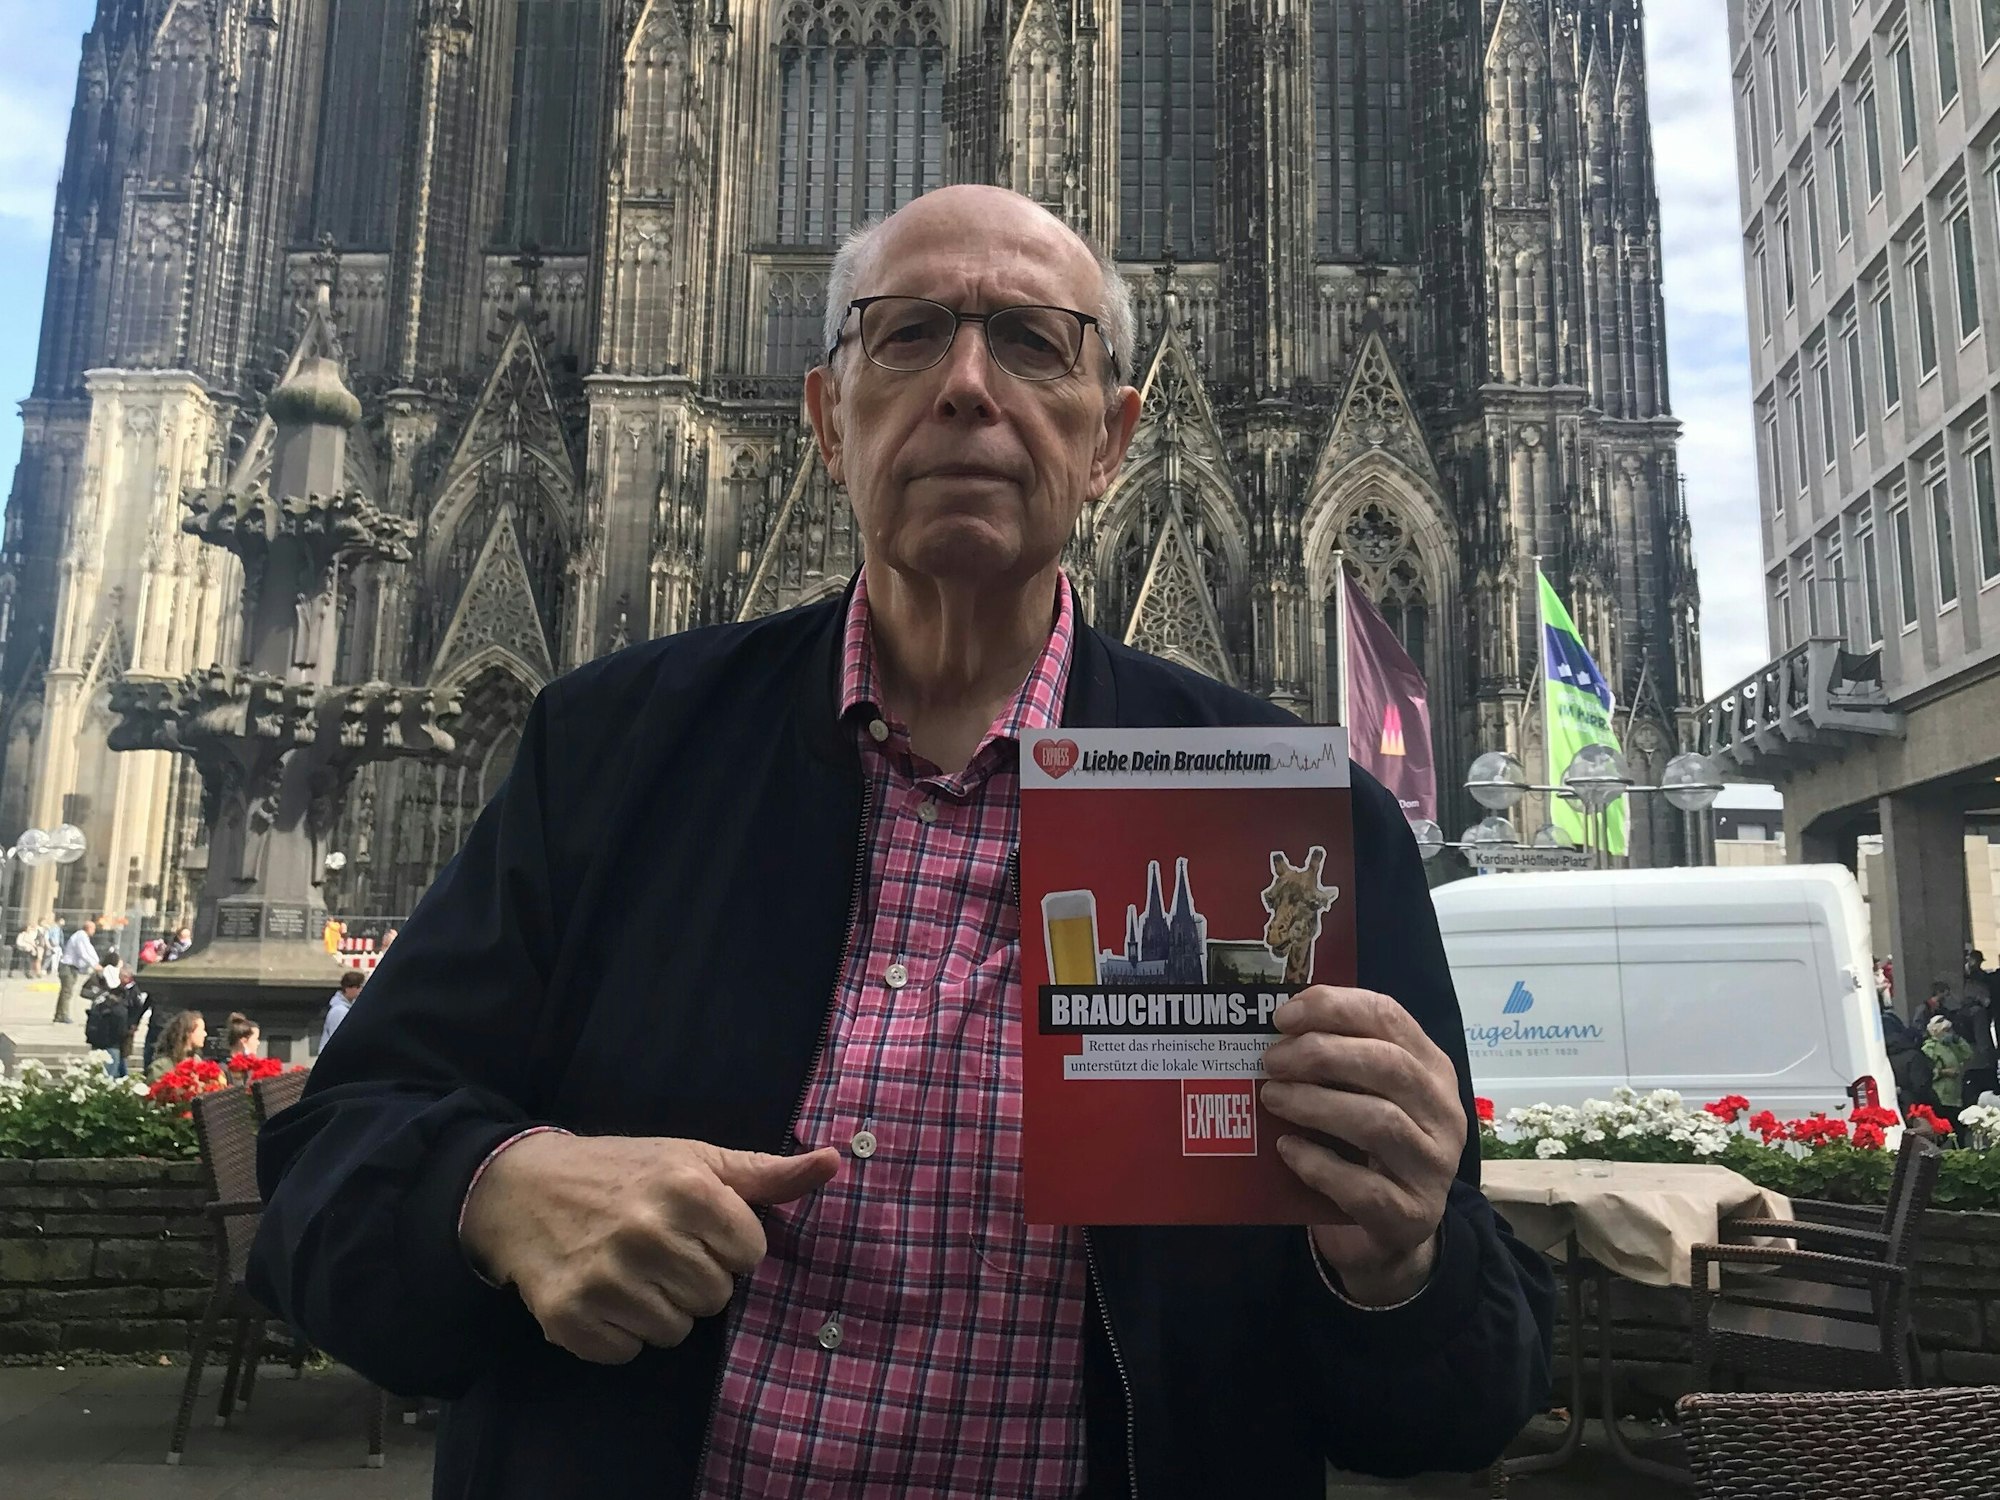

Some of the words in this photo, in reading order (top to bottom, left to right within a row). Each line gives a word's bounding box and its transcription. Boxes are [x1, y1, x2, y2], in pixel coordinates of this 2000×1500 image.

[1042, 747, 1070, 767] EXPRESS
[1082, 750, 1128, 771] Liebe
[1131, 750, 1171, 771] Dein
[1174, 750, 1271, 771] Brauchtum
[1475, 852, 1589, 868] Kardinal-Höffner-Platz
[1089, 1039, 1126, 1052] Rettet
[1128, 1039, 1149, 1052] das
[1151, 1039, 1215, 1052] rheinische
[1218, 1039, 1278, 1052] Braucht
[1071, 1059, 1138, 1072] unterstützt
[1141, 1059, 1159, 1072] die
[1162, 1059, 1198, 1072] lokale
[1202, 1058, 1265, 1072] Wirtschaft
[1186, 1093, 1252, 1140] EXPRESS
